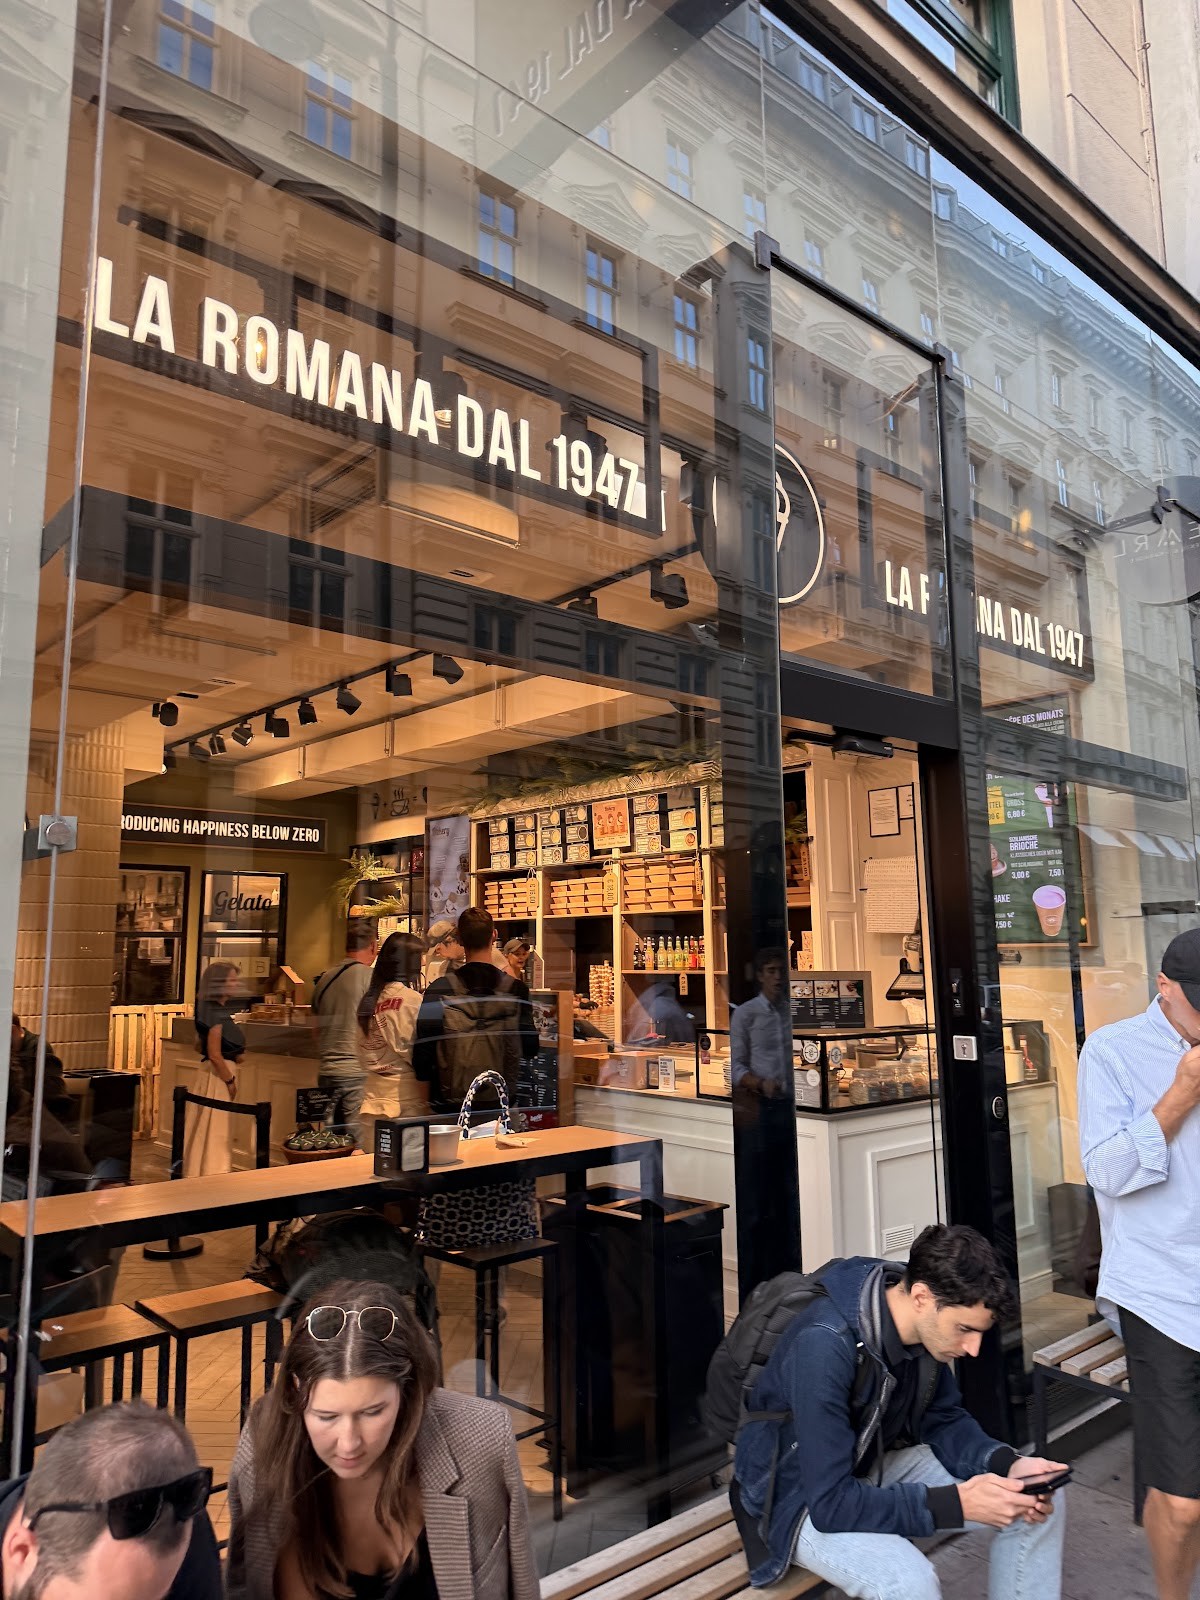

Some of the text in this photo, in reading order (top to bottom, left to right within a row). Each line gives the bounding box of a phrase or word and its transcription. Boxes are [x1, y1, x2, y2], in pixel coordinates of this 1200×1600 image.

[93, 256, 639, 514] LA ROMANA DAL 1947
[885, 560, 914, 611] LA
[1010, 606, 1046, 655] DAL
[1047, 622, 1084, 668] 1947
[1022, 713, 1035, 724] DES
[1036, 708, 1064, 721] MONATS
[121, 814, 320, 843] RODUCING HAPPINESS BELOW ZERO
[1009, 841, 1038, 851] BRIOCHE
[214, 890, 272, 915] Gelato
[994, 894, 1011, 903] HAKE
